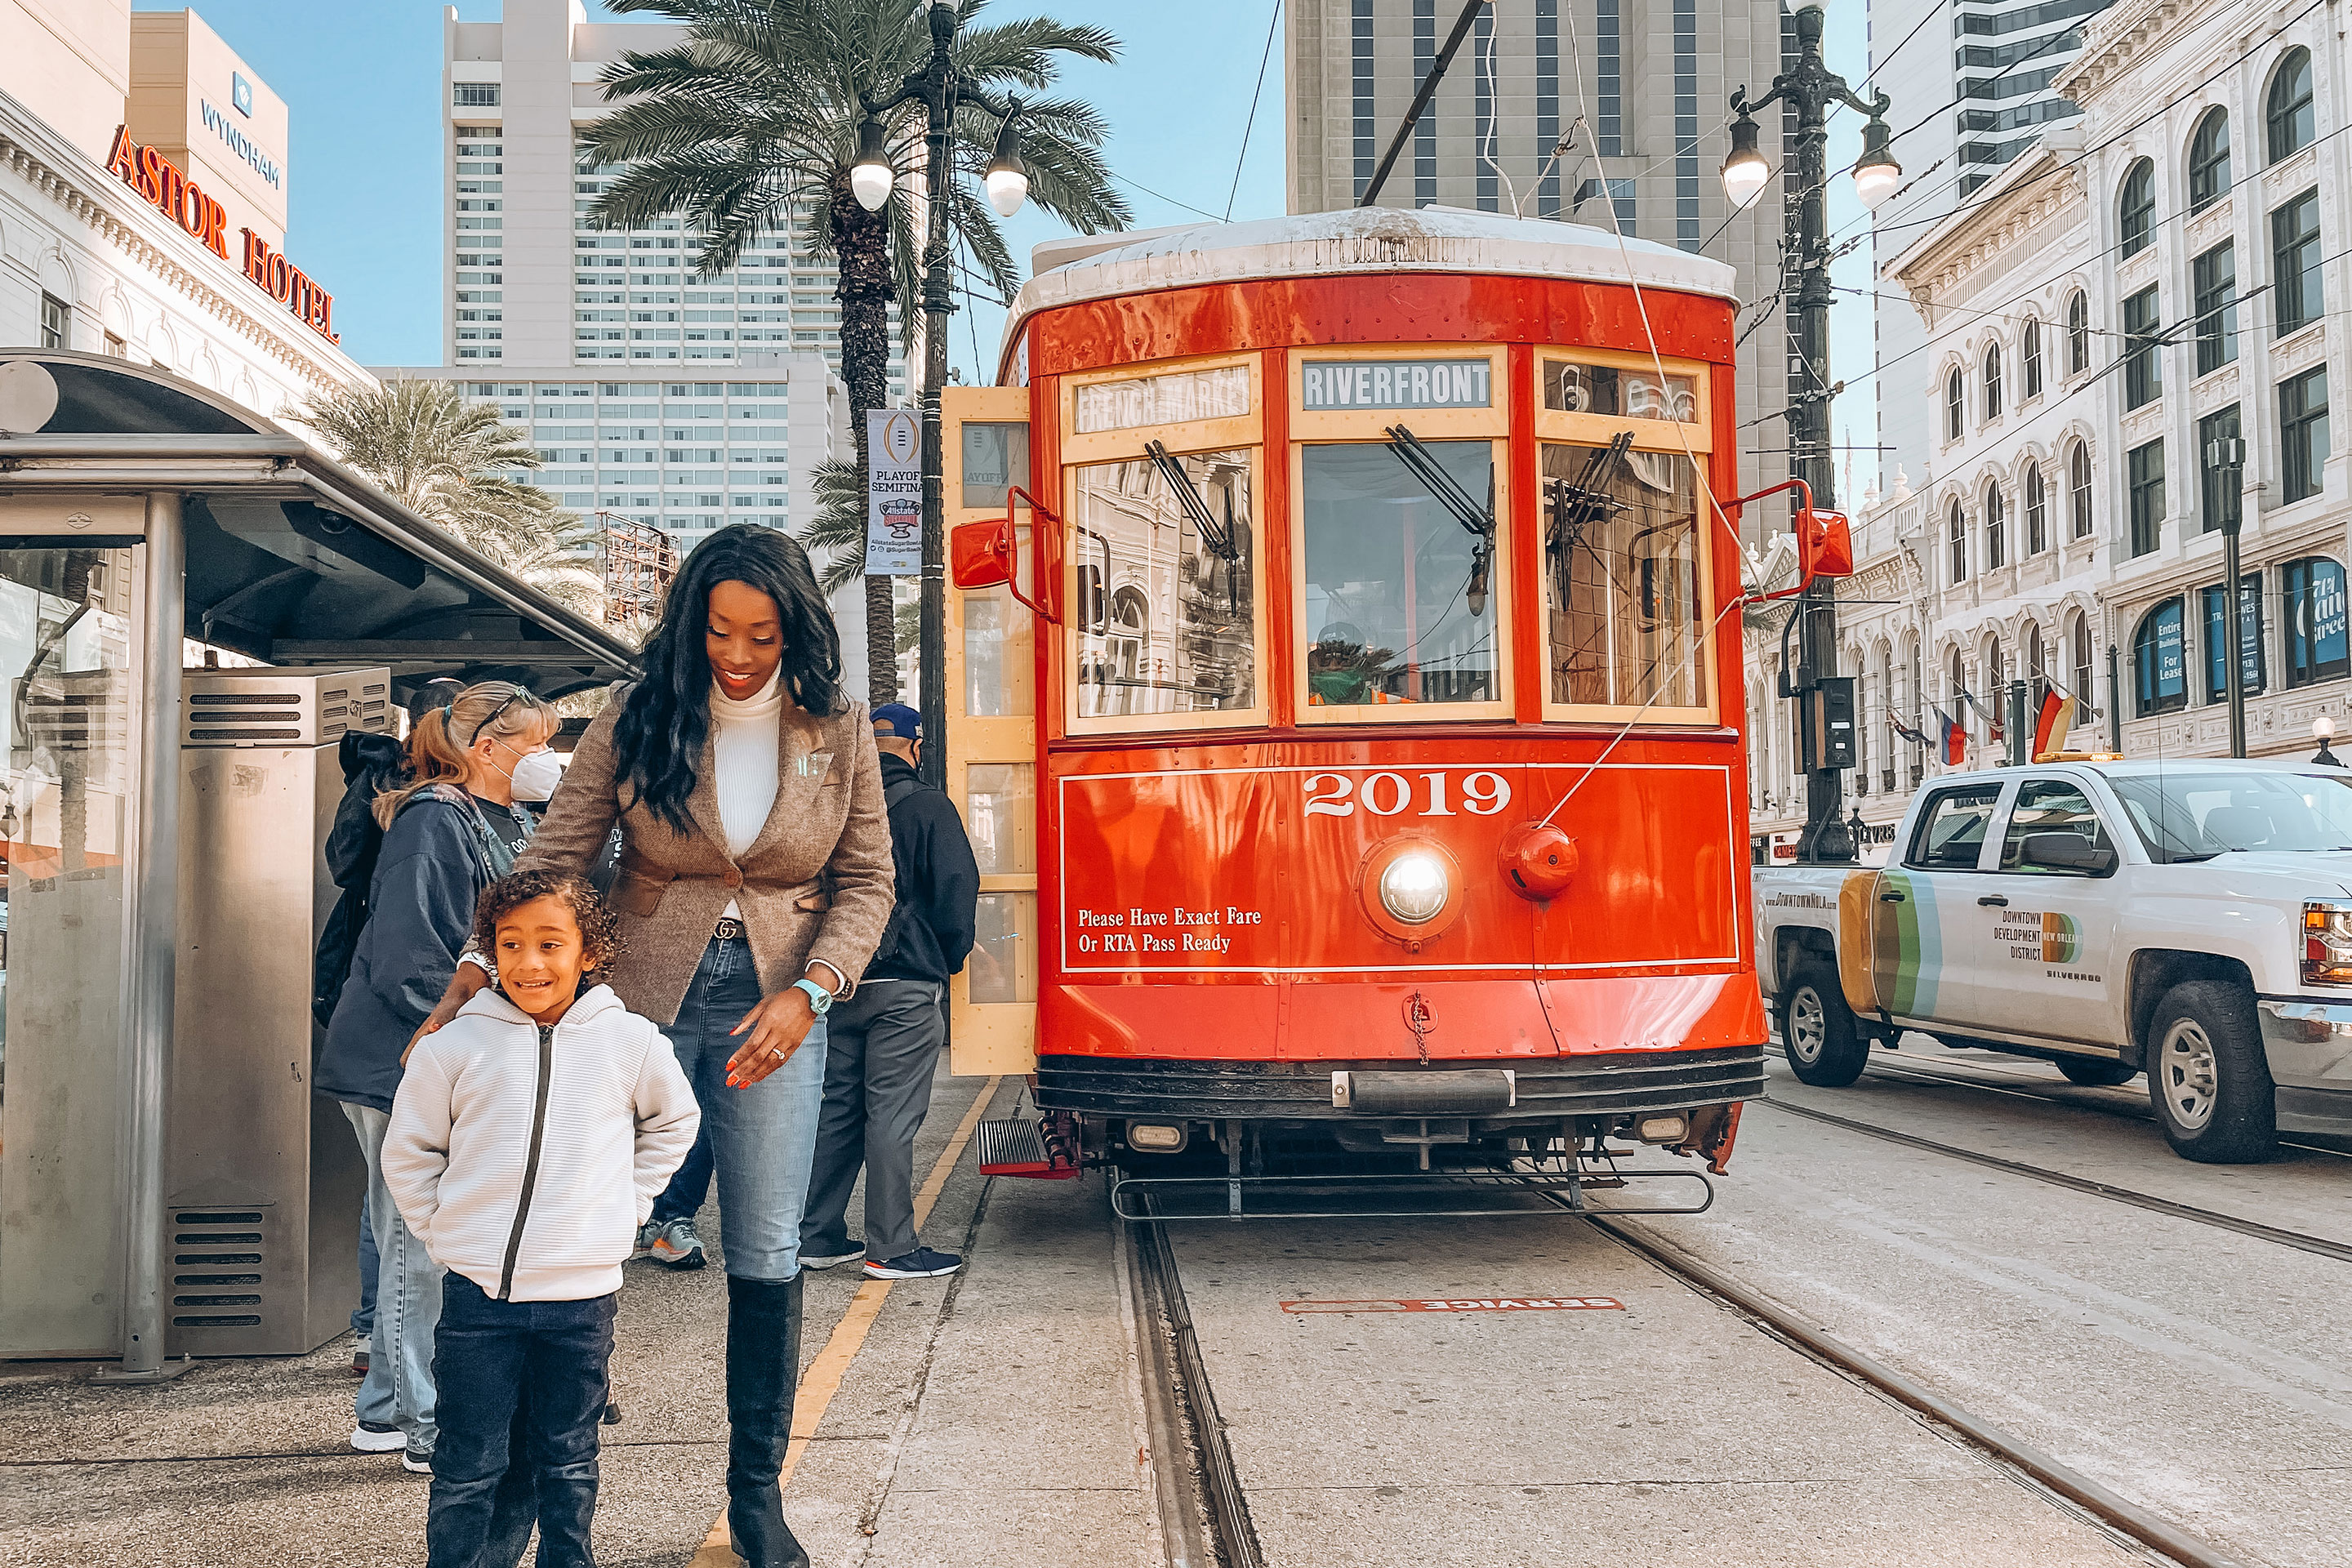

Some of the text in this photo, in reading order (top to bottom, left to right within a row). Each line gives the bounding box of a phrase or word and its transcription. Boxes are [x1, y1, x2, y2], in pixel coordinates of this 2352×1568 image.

[201, 98, 280, 189] WYNDHAM
[108, 123, 341, 346] ASTOR HOTEL
[1305, 364, 1490, 405] RIVERFRONT
[876, 470, 922, 480] PLAYOF
[872, 482, 923, 492] SEMIFINA
[885, 506, 915, 514] Allstate
[2158, 621, 2180, 636] Entire
[2164, 657, 2177, 668] For
[2159, 667, 2182, 680] Lease
[1303, 772, 1511, 817] 2019
[1078, 906, 1262, 927] Please Have Exact Fare
[2002, 911, 2041, 924] DOWNTOWN
[1994, 927, 2040, 942] DEVELOPMENT
[2043, 932, 2083, 944] NEW ORLEANS
[1079, 933, 1232, 954] Or RTA Pass Ready
[2011, 946, 2041, 961] DISTRICT
[2047, 970, 2101, 982] SILVERADO
[1420, 1298, 1616, 1310] SERVICE
